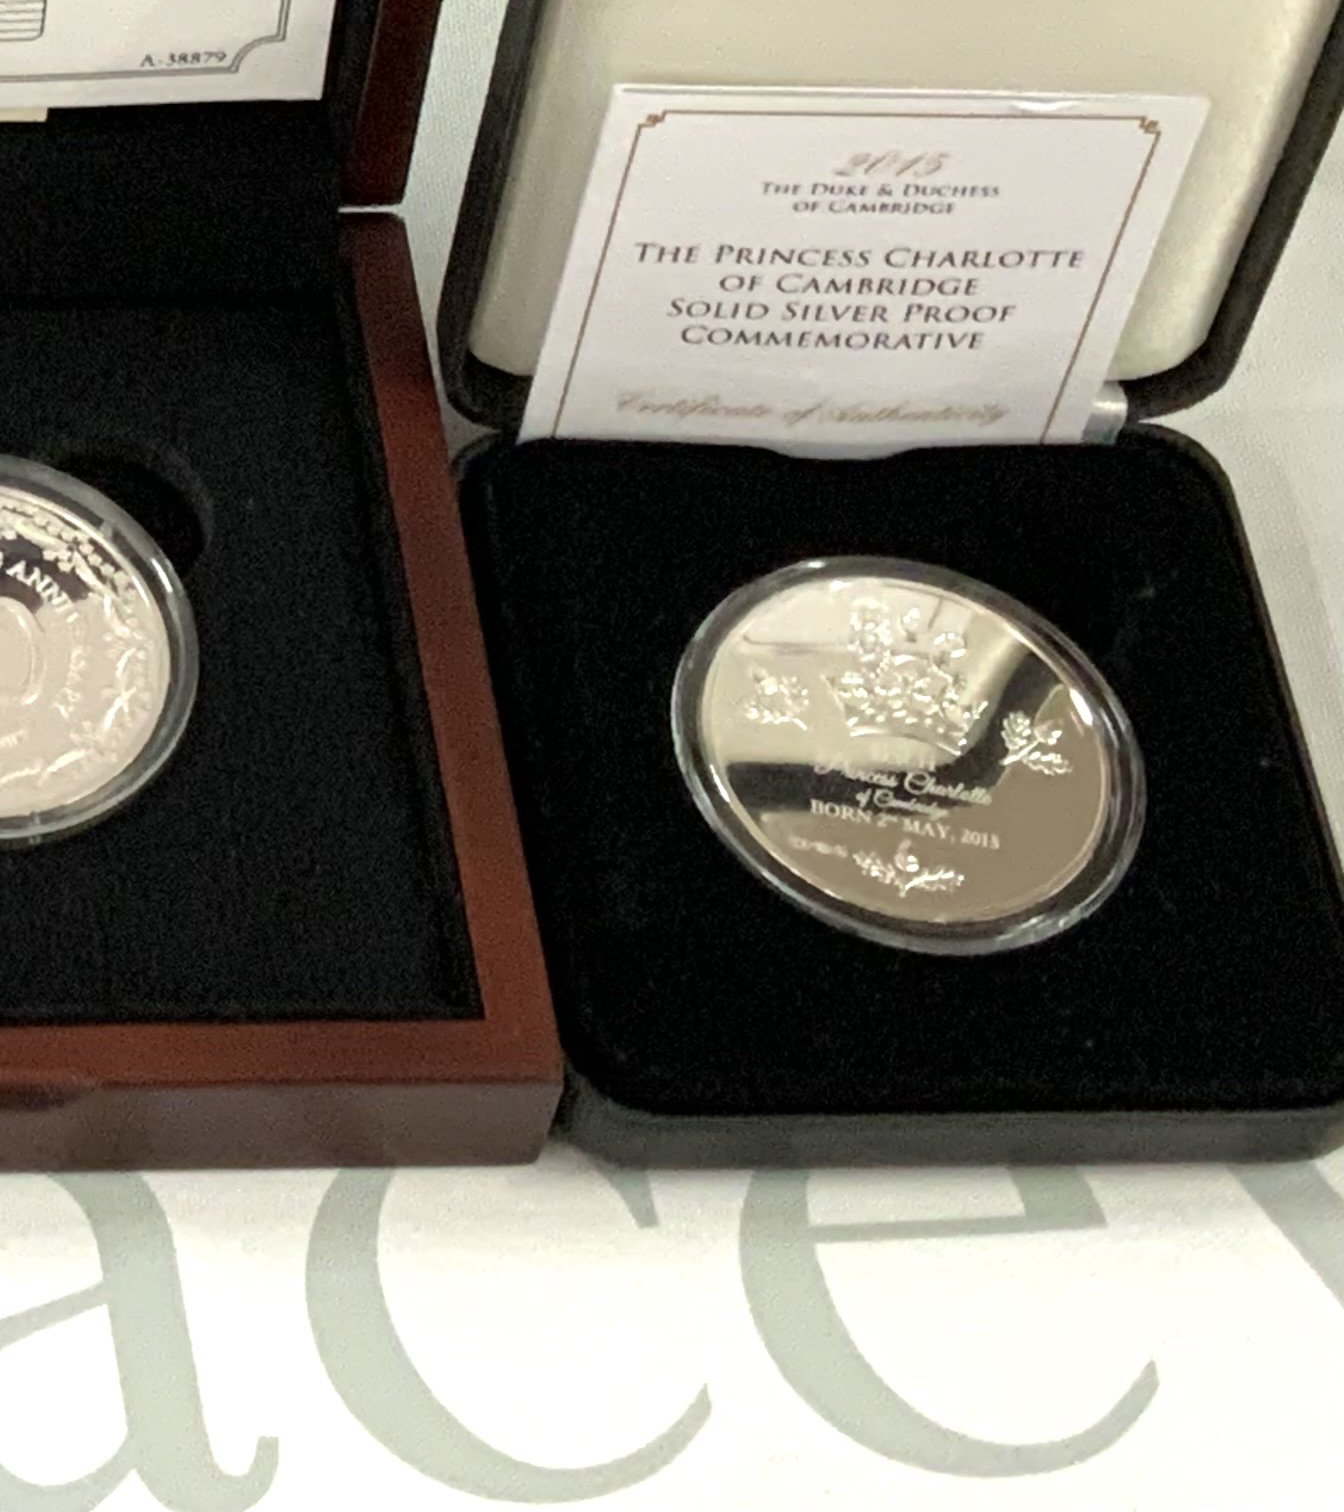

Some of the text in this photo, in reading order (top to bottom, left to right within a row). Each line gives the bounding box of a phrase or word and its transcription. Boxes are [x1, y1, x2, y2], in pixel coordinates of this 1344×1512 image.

[876, 184, 893, 197] &
[715, 244, 872, 268] PRINCESS
[884, 247, 1085, 270] CHARLOTTE
[776, 273, 979, 297] CAMBRIDGE
[668, 298, 1017, 324] SOLID SILVER PROOF
[680, 325, 984, 351] COMMEMORATIVE
[810, 798, 872, 824] BORN
[961, 829, 1000, 850] 2015
